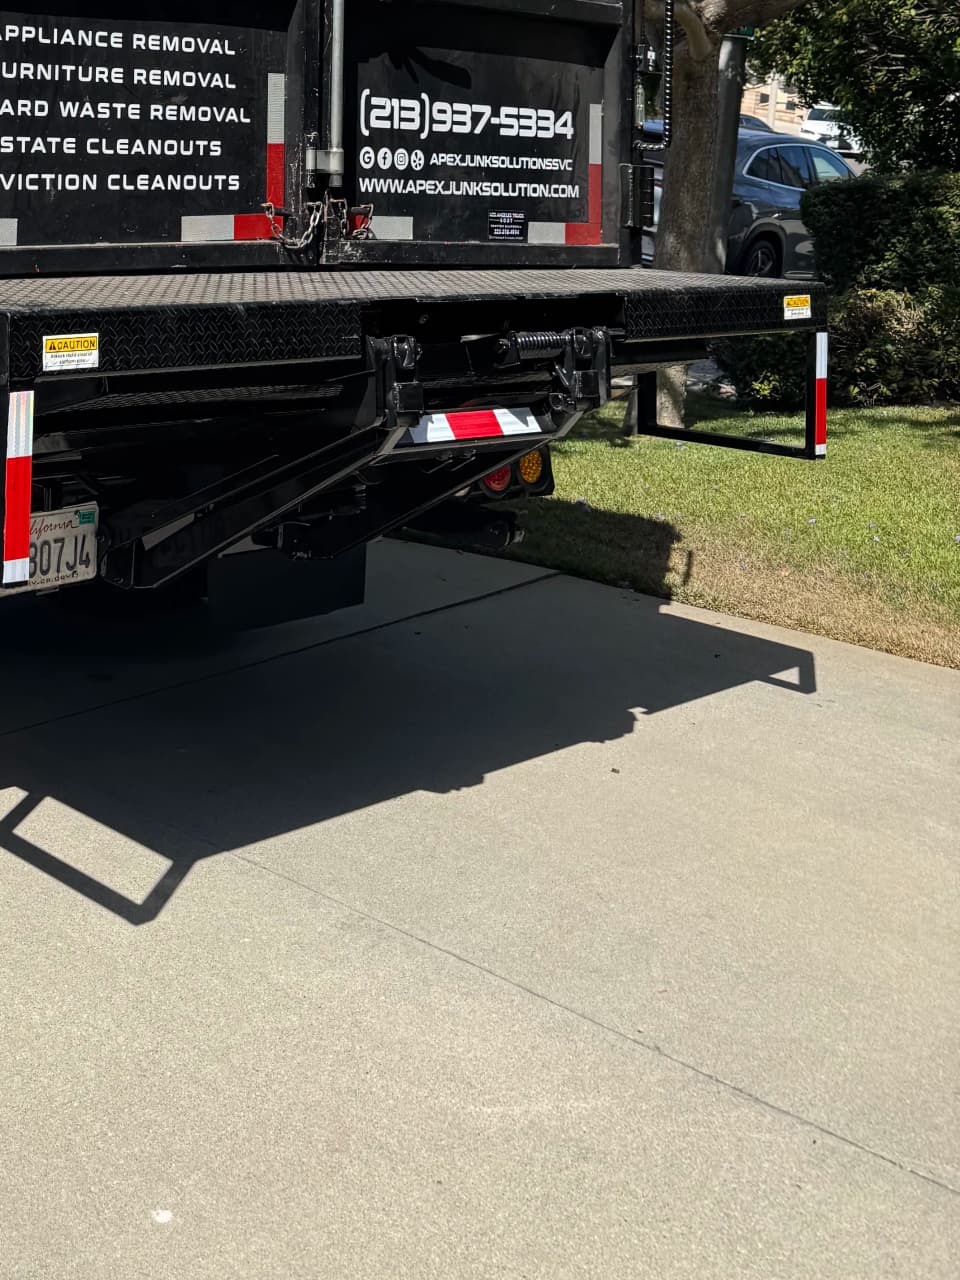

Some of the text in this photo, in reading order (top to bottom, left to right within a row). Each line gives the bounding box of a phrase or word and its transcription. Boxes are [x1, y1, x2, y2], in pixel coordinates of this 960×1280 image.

[132, 33, 236, 55] REMOVAL
[133, 68, 237, 89] REMOVAL
[59, 101, 141, 120] WASTE
[150, 104, 251, 123] REMOVAL
[360, 88, 575, 140] (213)937-5334
[86, 138, 222, 156] CLEANOUTS
[430, 152, 573, 171] APEXJUNKSOLUTIONSSVC
[107, 174, 240, 191] CLEANOUTS
[359, 177, 580, 199] WWW.APEXJUNKSOLUTION.COM
[57, 339, 96, 350] CAUTION
[29, 519, 80, 540] lifornia
